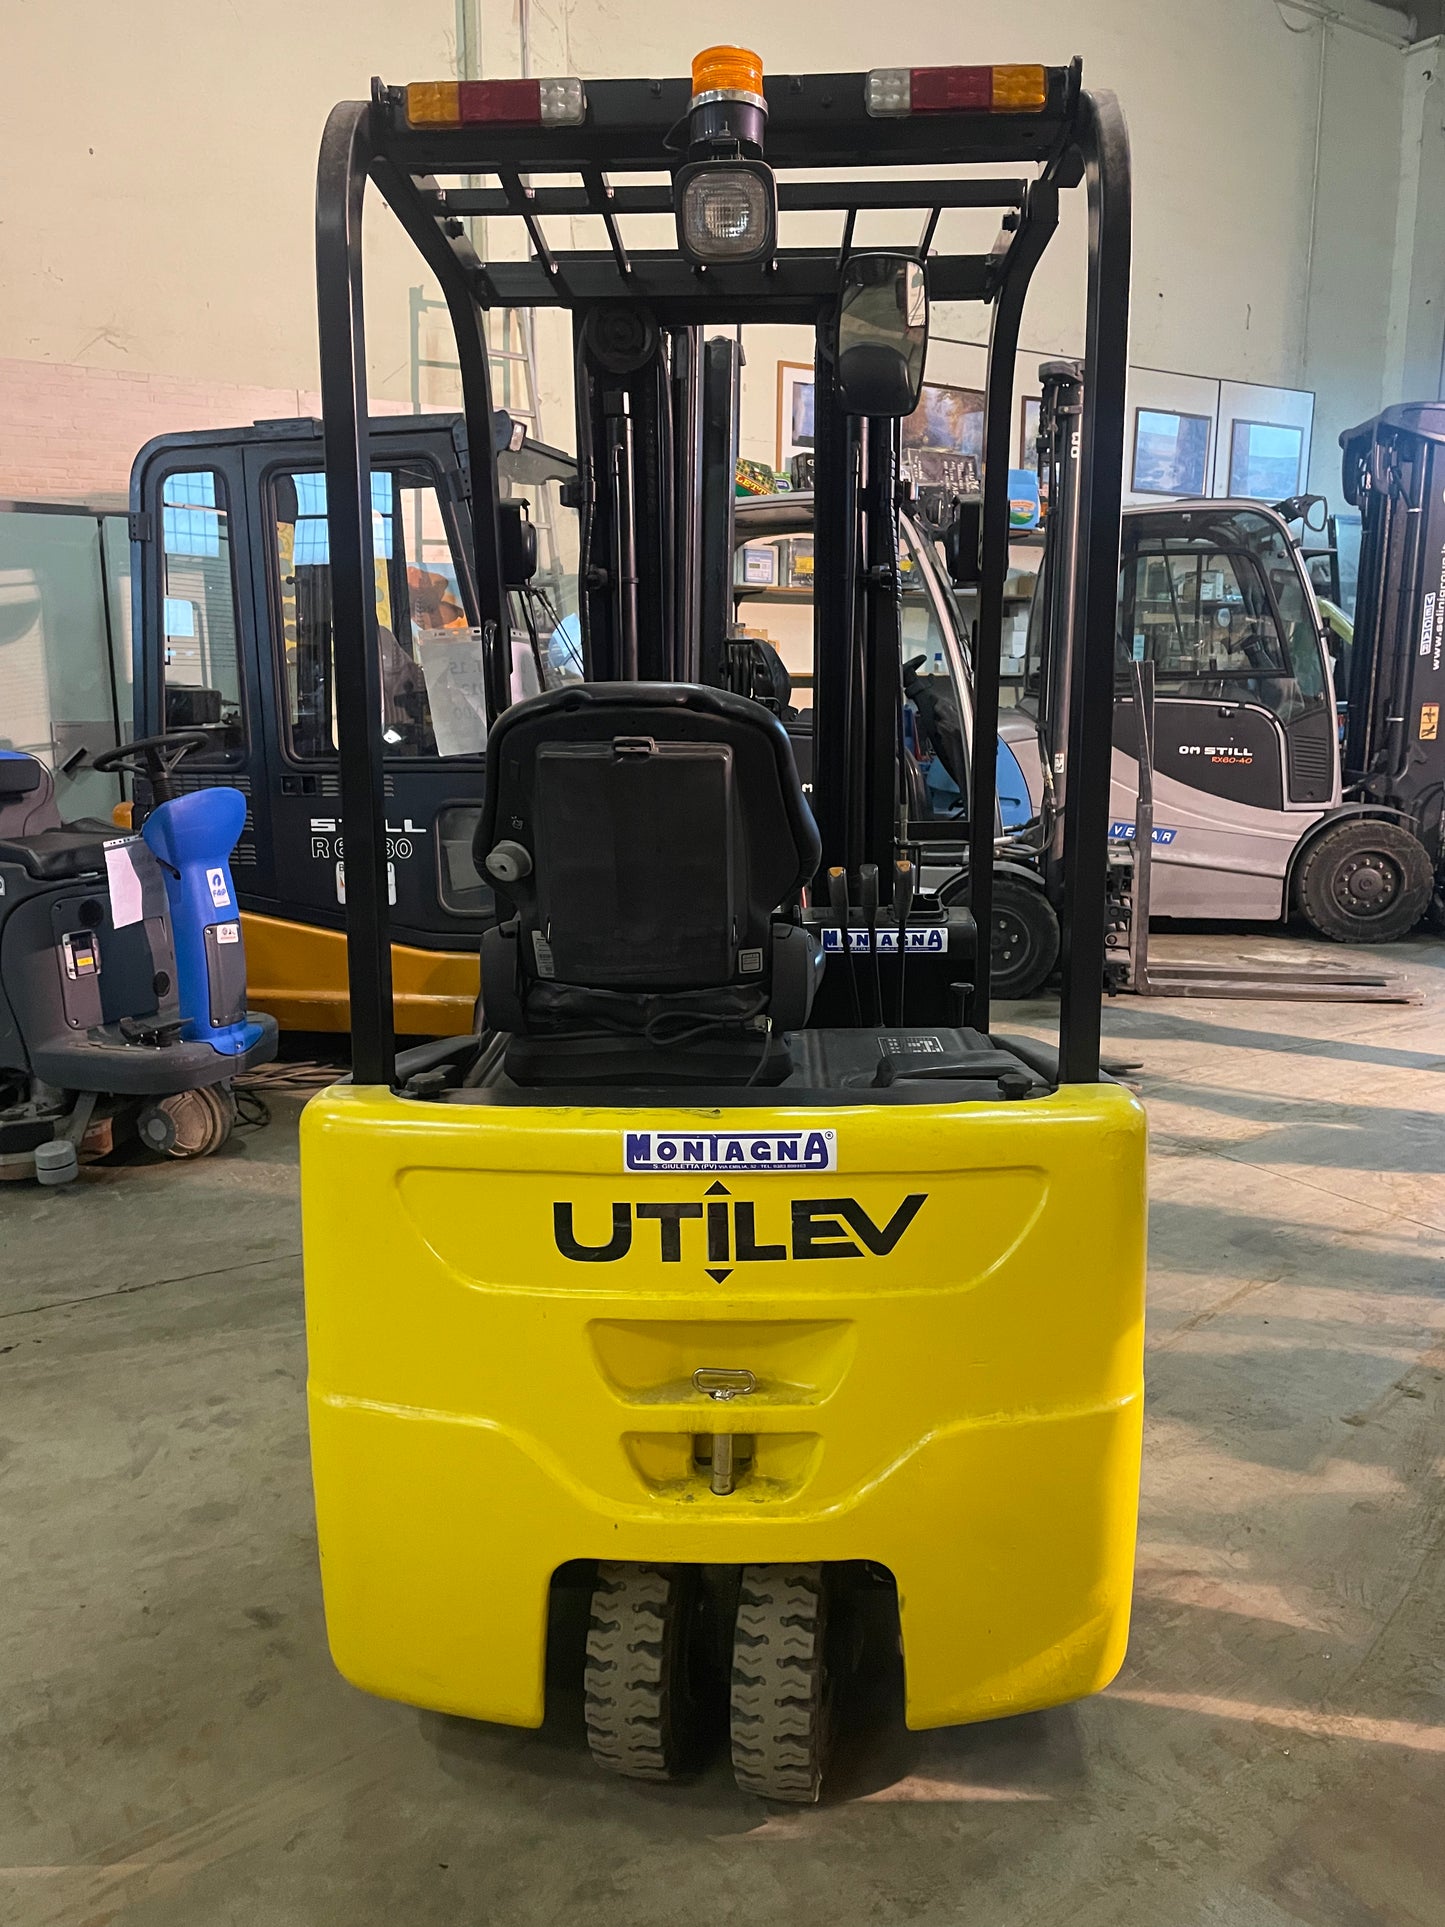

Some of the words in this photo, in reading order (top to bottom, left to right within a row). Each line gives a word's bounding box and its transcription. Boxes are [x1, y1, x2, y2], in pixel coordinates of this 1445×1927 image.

[1432, 543, 1445, 671] www.selinigroui
[1179, 746, 1200, 755] OM
[1204, 746, 1253, 756] STILL
[310, 818, 427, 832] SLL
[1114, 825, 1173, 842] VEAR
[822, 929, 943, 947] MONAGNA
[626, 1132, 830, 1162] MONTAGNA
[553, 1194, 929, 1263] UTILEV
